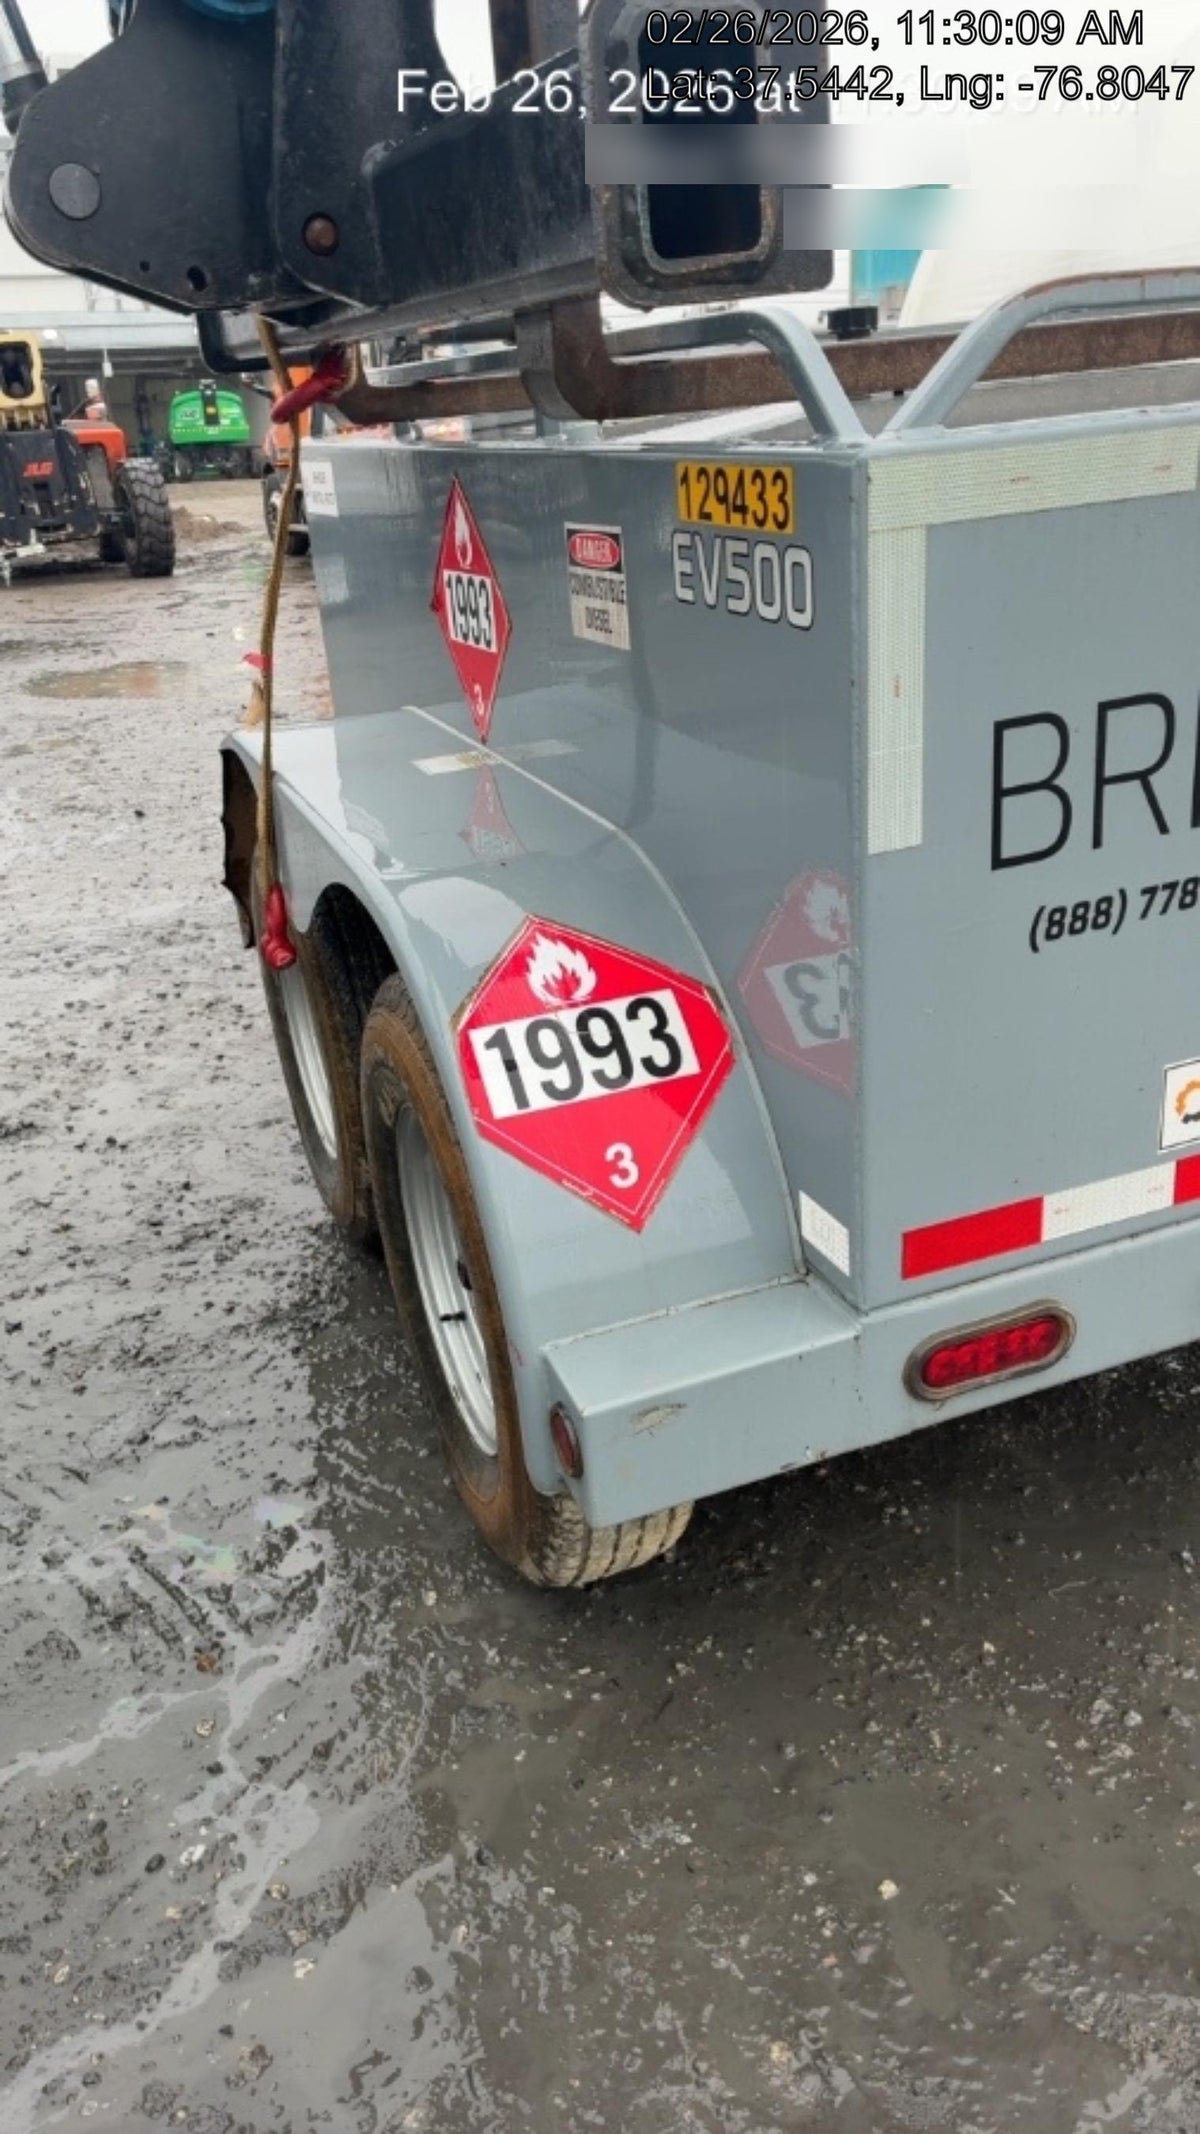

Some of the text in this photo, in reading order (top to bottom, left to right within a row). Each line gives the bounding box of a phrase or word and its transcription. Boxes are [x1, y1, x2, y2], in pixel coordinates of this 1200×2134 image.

[680, 466, 790, 530] 129433
[575, 537, 613, 562] DANGER
[672, 529, 815, 631] EV500
[447, 574, 491, 649] 1993
[474, 684, 484, 716] 3
[1029, 876, 1200, 953] (888) 778
[484, 996, 683, 1111] 1993
[605, 1142, 639, 1189] 3
